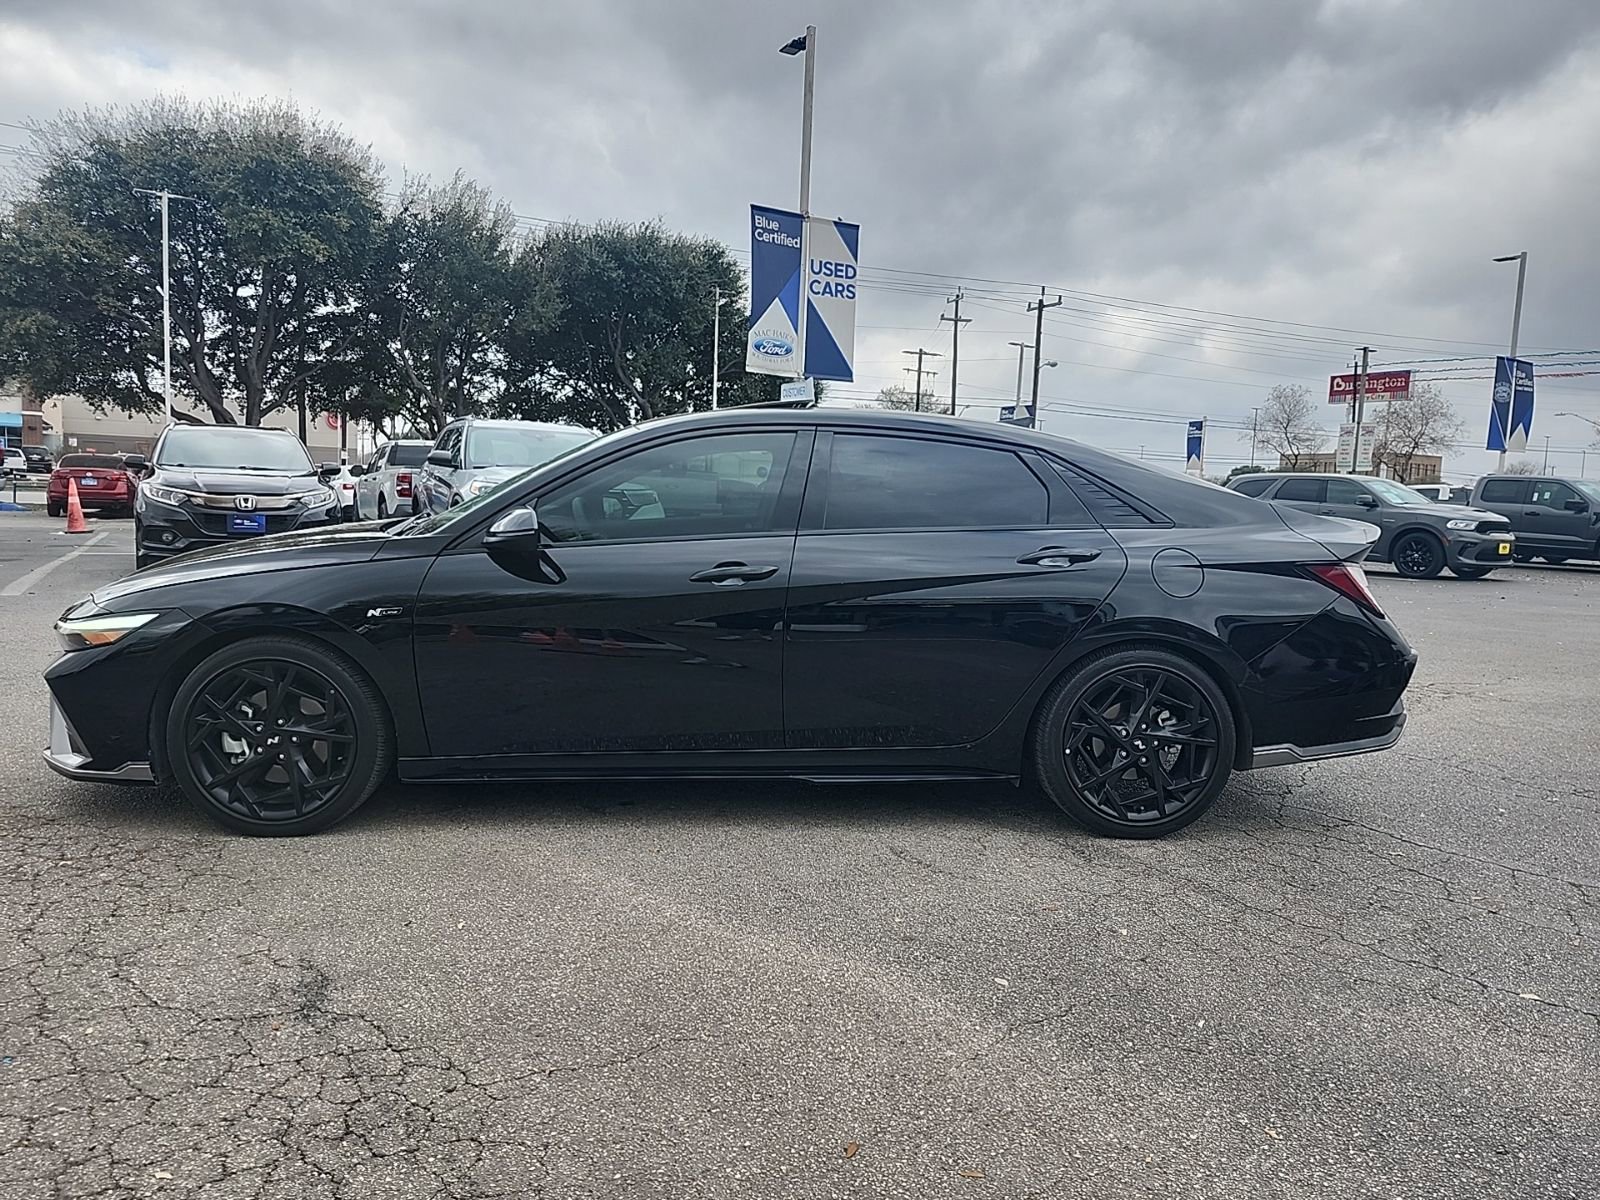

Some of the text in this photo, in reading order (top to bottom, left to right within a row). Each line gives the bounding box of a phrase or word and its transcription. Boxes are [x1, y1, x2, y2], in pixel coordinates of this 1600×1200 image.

[755, 215, 780, 231] Blue
[754, 229, 800, 248] Certified
[810, 259, 857, 280] USED
[809, 279, 857, 300] CARS
[754, 329, 771, 339] MAC
[759, 339, 788, 355] Ford
[1333, 376, 1406, 392] Buington
